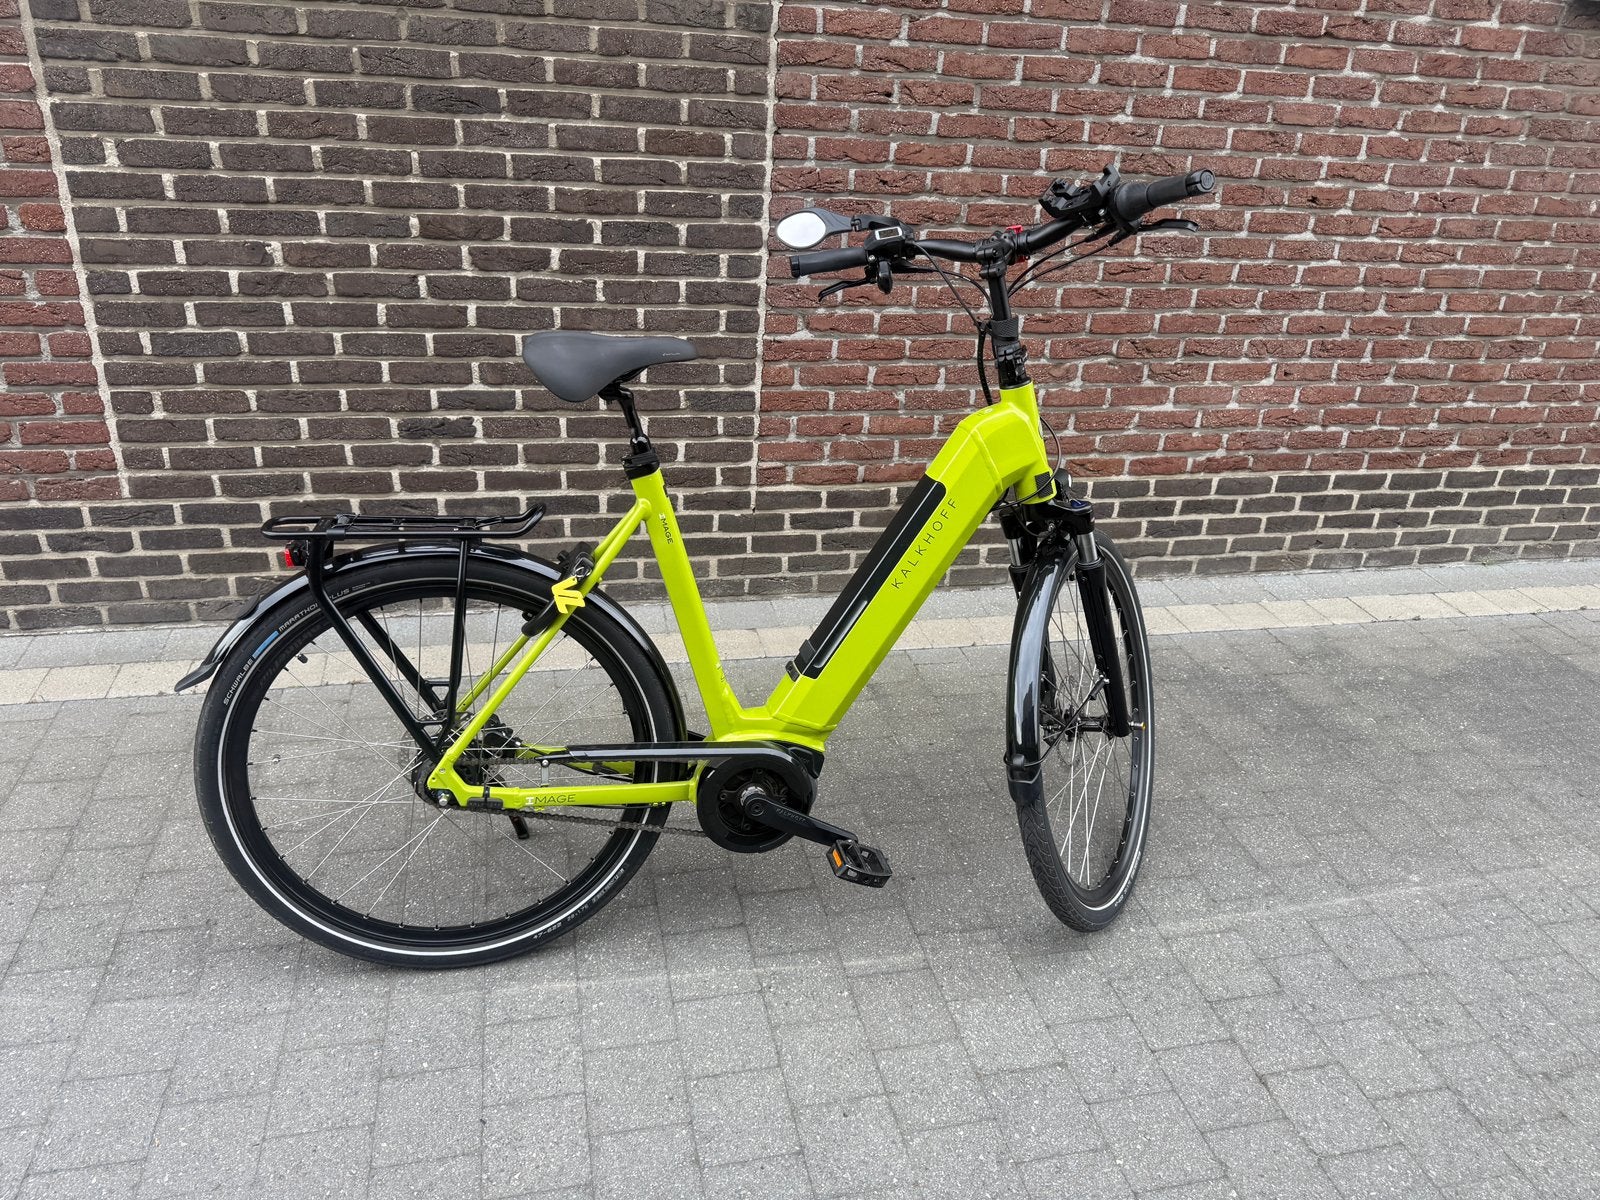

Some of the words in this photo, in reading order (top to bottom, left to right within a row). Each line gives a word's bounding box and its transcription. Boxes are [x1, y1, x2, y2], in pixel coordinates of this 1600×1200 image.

[891, 498, 957, 589] KALKHOFF
[223, 658, 254, 706] SCHWALBE
[329, 588, 350, 599] LUS
[525, 794, 576, 805] IMAGE
